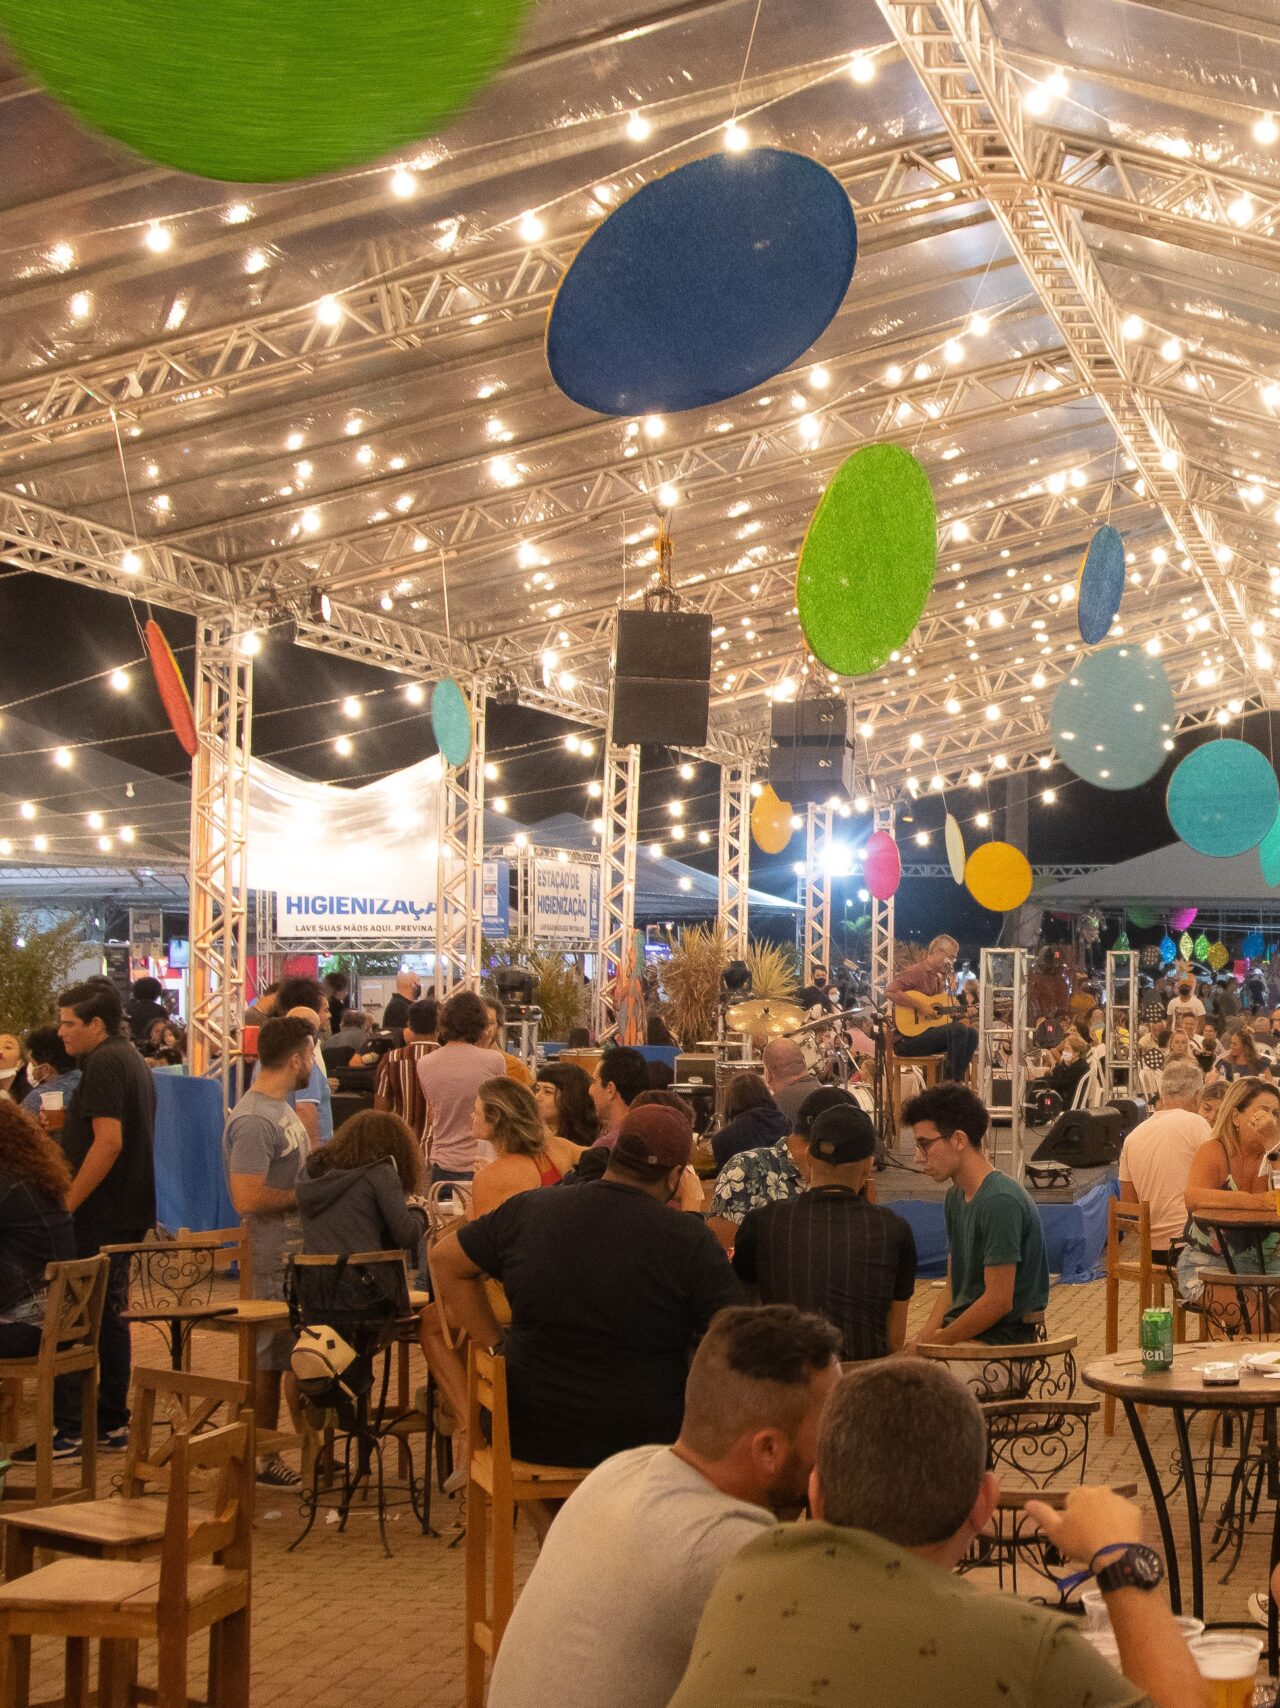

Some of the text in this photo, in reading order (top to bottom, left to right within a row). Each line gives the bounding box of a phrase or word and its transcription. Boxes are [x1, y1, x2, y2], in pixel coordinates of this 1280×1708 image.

[537, 868, 570, 893] ESTAÇÃO
[571, 872, 580, 890] DE
[286, 896, 460, 920] HIGIENIZAÇ
[537, 894, 587, 921] HIGIENIZAÇÃO
[295, 924, 317, 932] LAVE
[318, 924, 342, 932] SUAS
[343, 922, 368, 932] MÃOS
